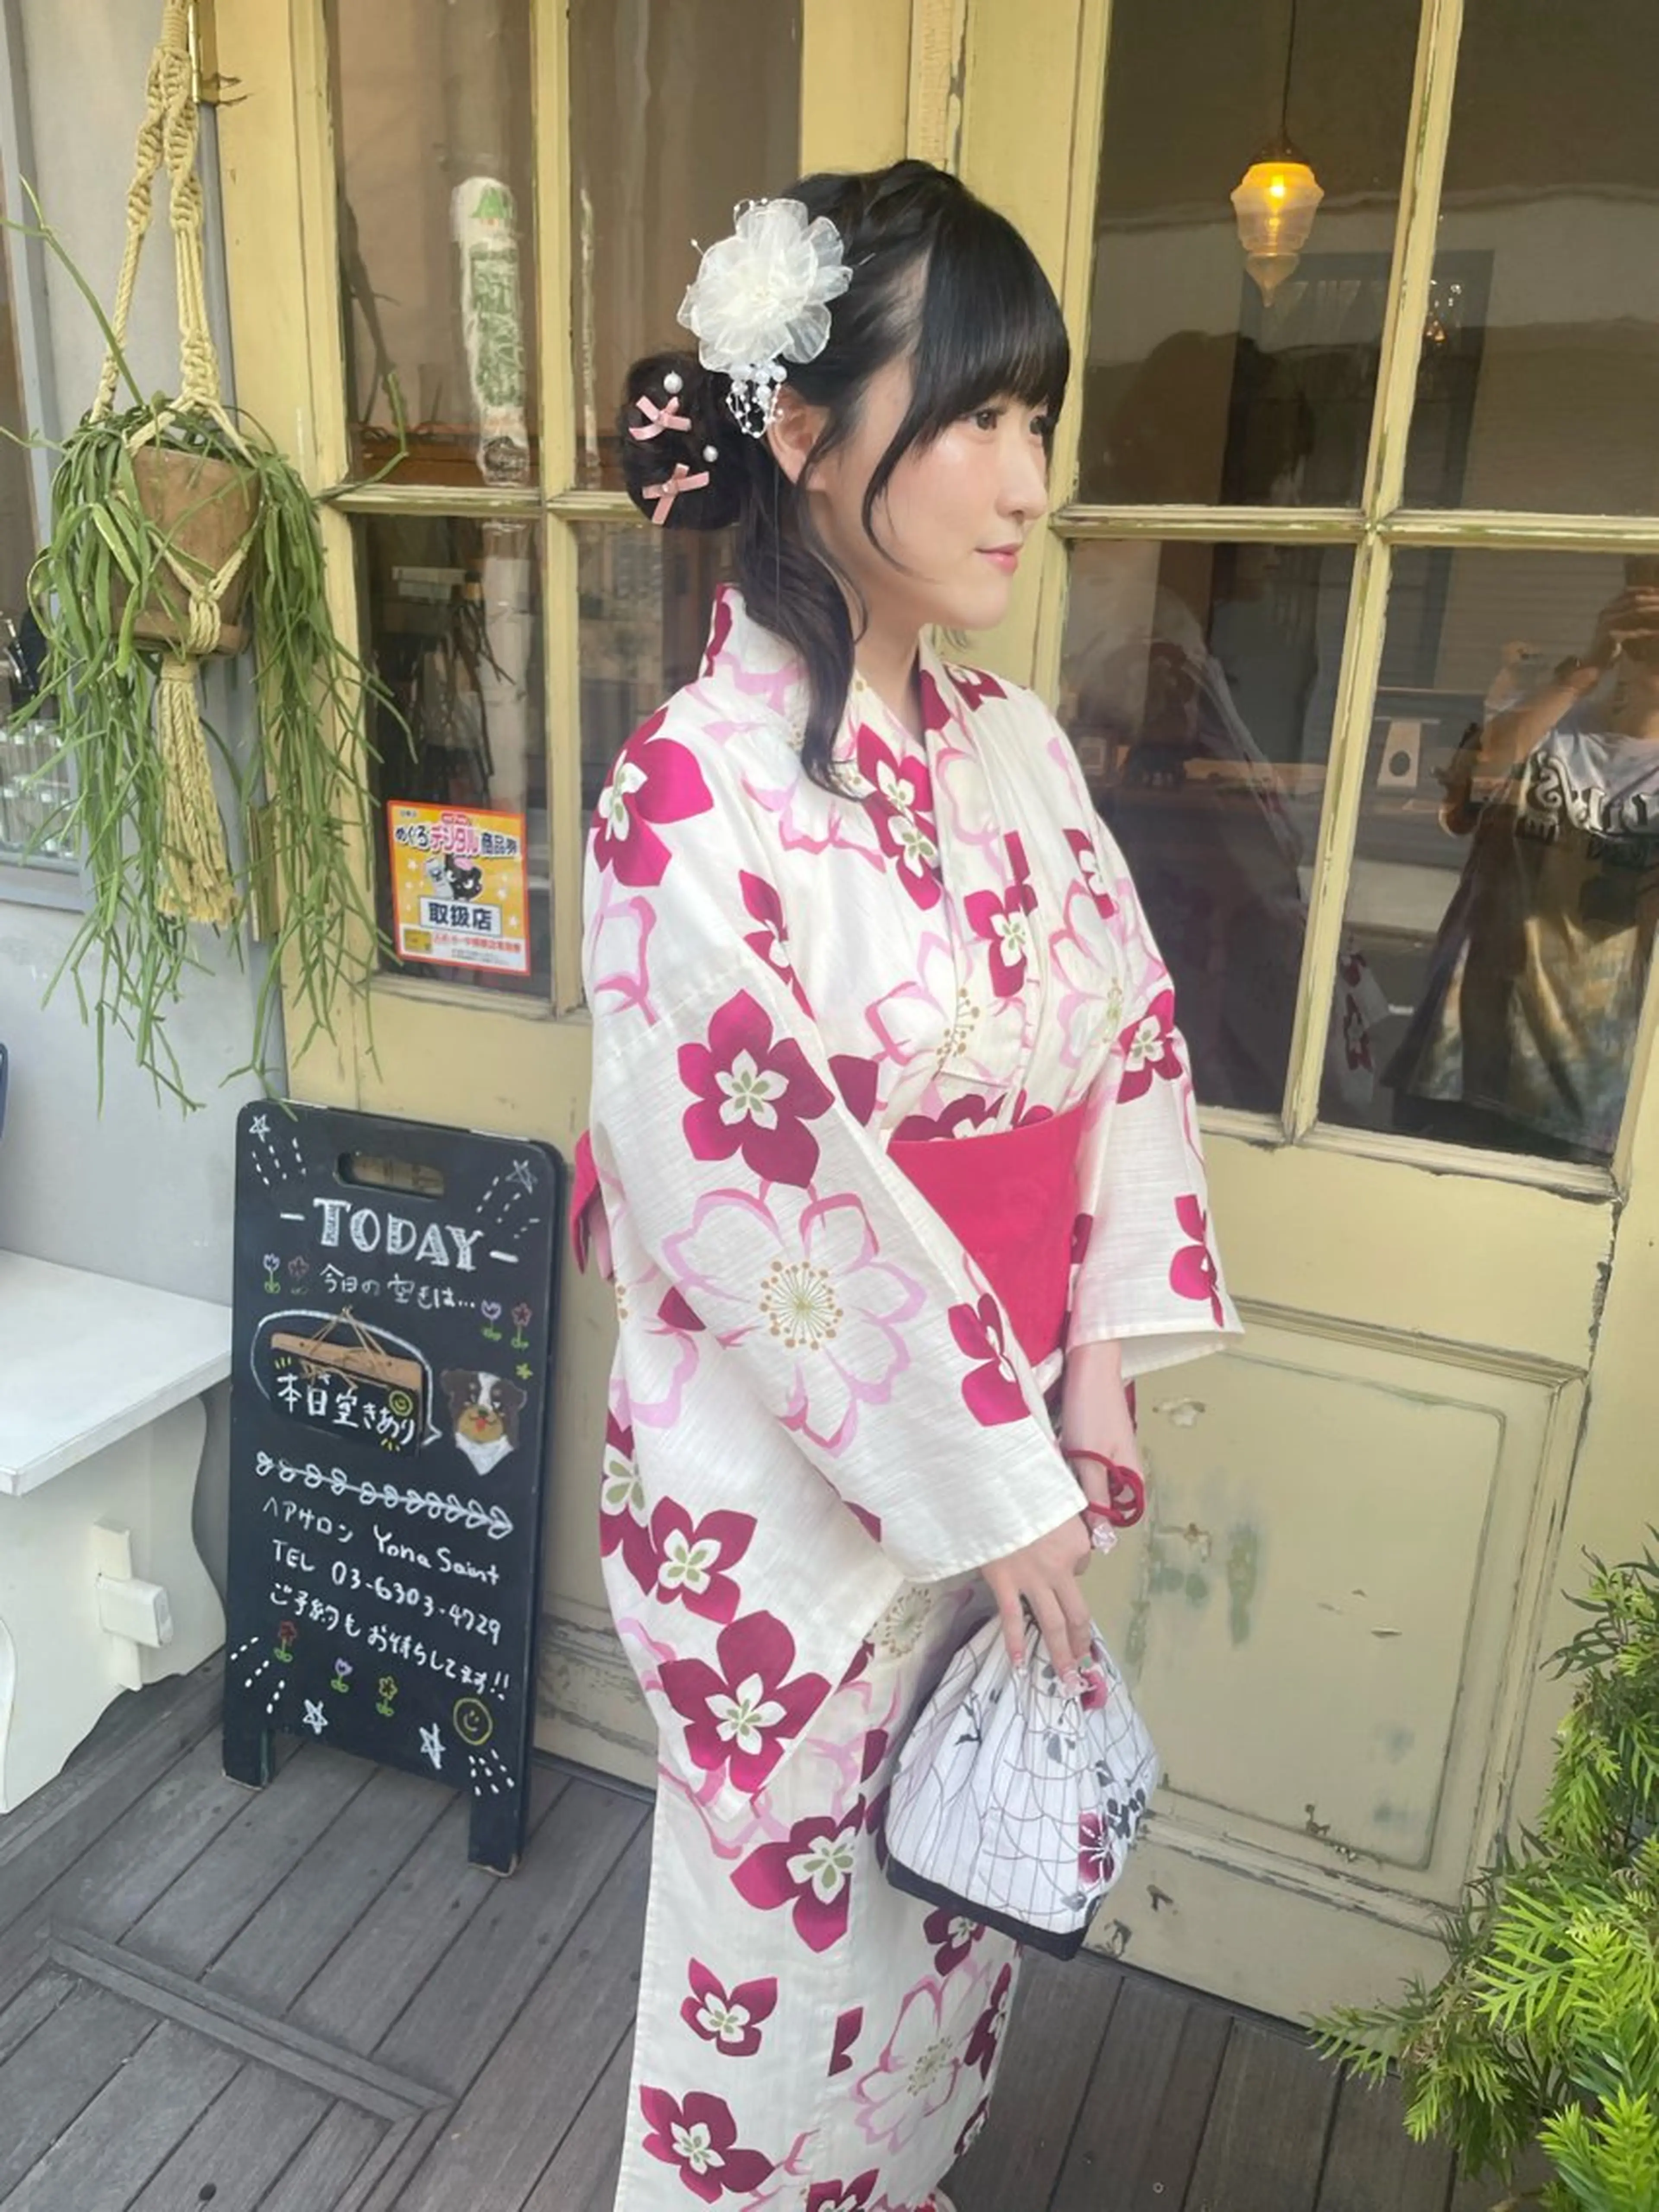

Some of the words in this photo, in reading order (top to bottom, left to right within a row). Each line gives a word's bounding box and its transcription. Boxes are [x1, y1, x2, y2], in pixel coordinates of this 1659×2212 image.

[429, 902, 492, 931] 取扱店
[313, 1197, 484, 1272] TODAY
[276, 1372, 415, 1445] 本日空きあり
[262, 1496, 353, 1543] ヘアサロン
[436, 1546, 500, 1586] Saint
[272, 1538, 316, 1572] TEL
[331, 1560, 501, 1646] 03-6303-4729
